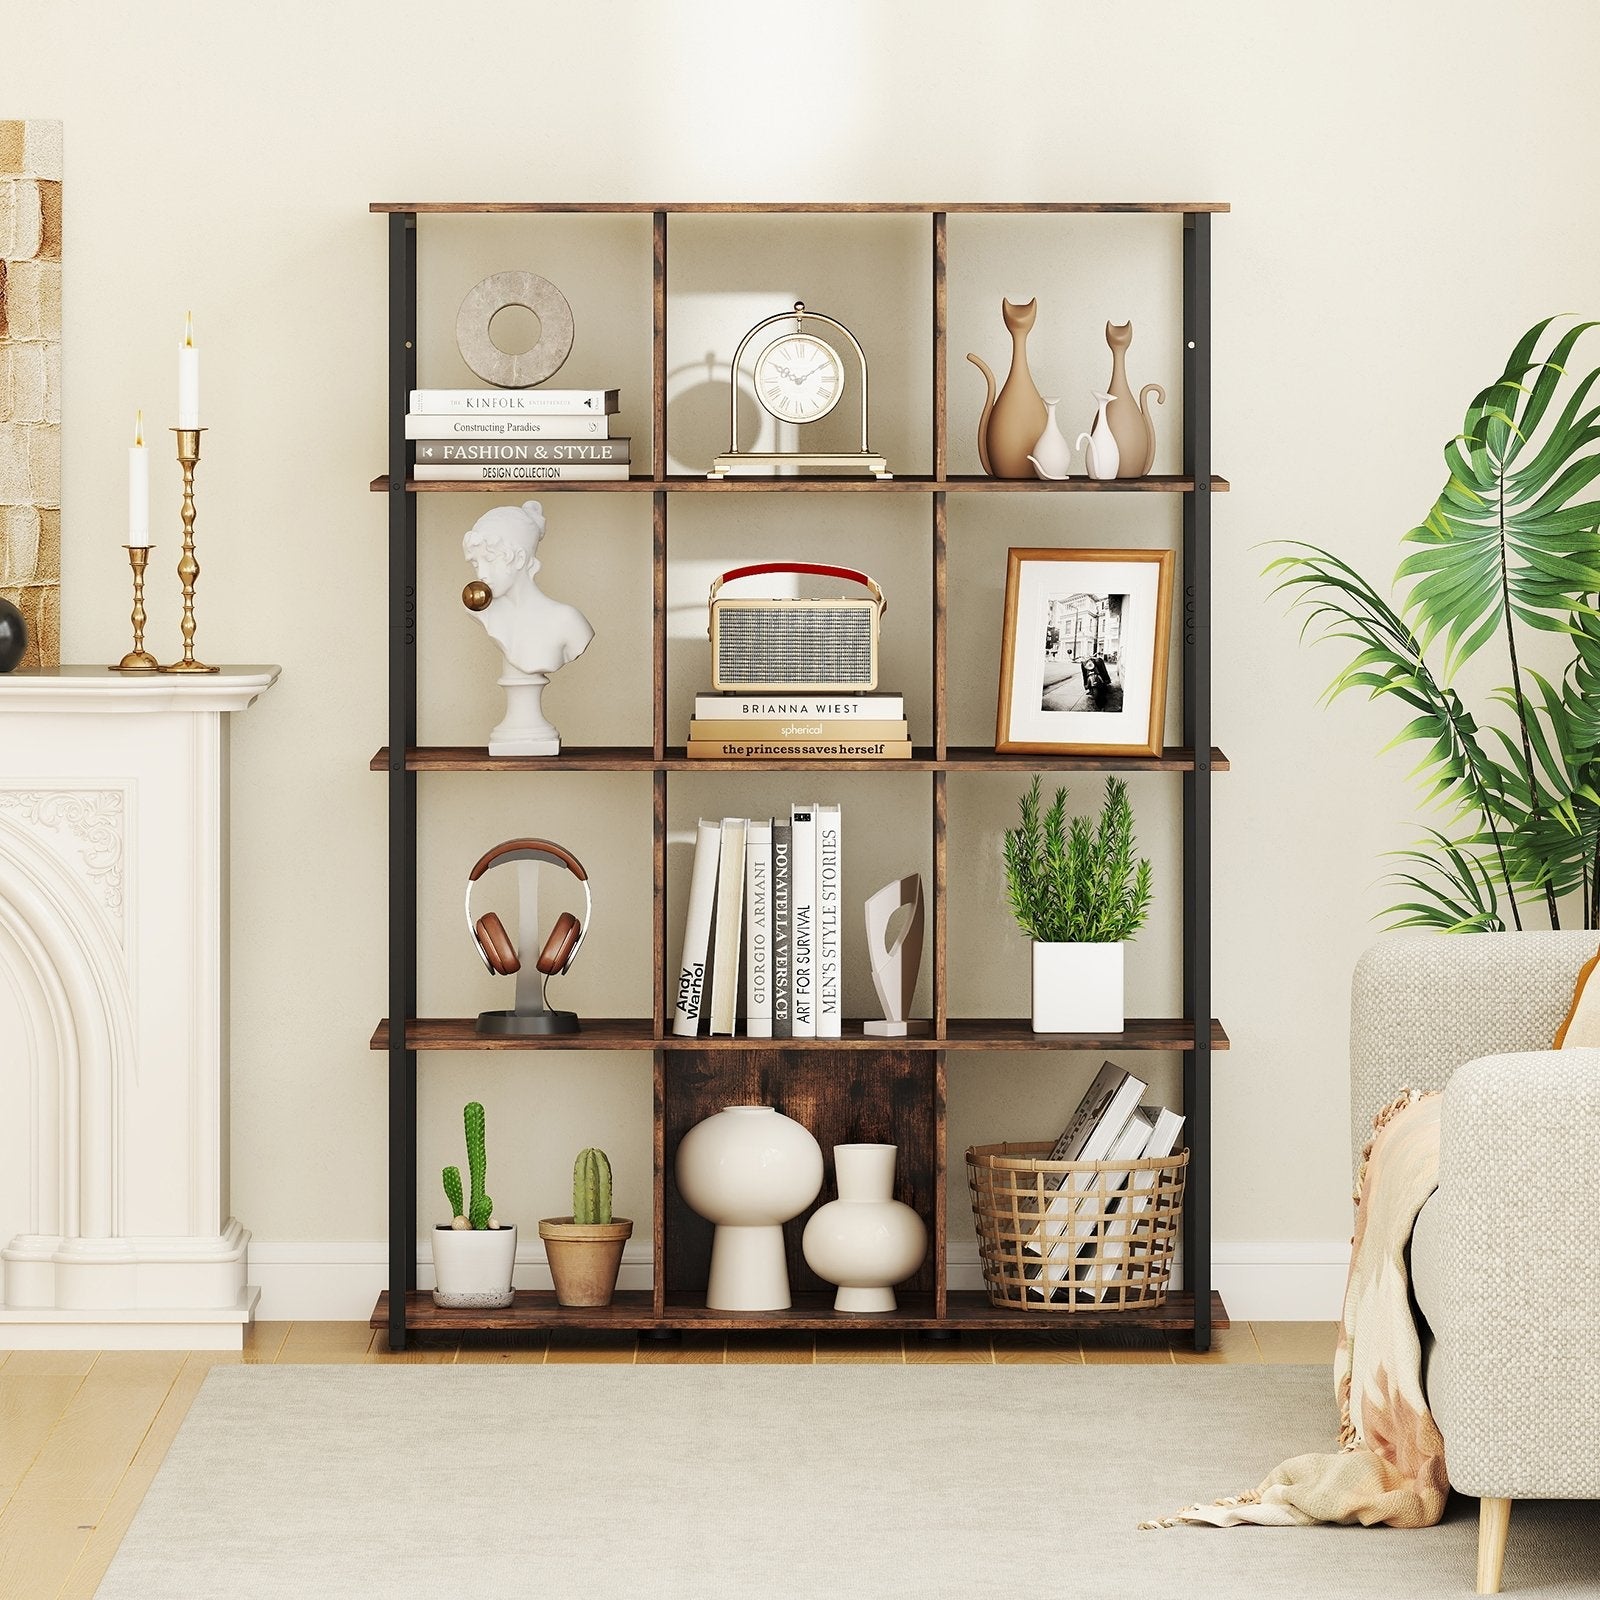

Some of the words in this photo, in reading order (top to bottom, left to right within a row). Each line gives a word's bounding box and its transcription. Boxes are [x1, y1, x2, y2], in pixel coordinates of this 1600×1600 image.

[466, 398, 525, 409] KINFOLK
[453, 422, 505, 435] Constructing
[507, 422, 541, 433] Paradies
[443, 445, 529, 460] FASHION
[534, 445, 549, 460] &
[553, 445, 613, 460] STYLE
[482, 467, 512, 479] DESIGN
[513, 467, 561, 479] COLLECTION
[742, 704, 809, 713] BRIANNA
[816, 704, 859, 713] WIEST
[781, 723, 823, 737] spherical
[722, 744, 745, 755] the
[746, 744, 801, 757] princess
[802, 747, 838, 755] saves
[839, 744, 886, 755] herself
[821, 830, 837, 901] STORIES
[753, 861, 766, 928] ARMANI
[775, 843, 788, 942] DONATELLA
[796, 904, 811, 964] SURVIVAL
[821, 905, 837, 958] STYLE
[753, 933, 766, 1004] GIORGIO
[775, 944, 788, 1021] VERSACE
[796, 968, 811, 995] FOR
[676, 967, 694, 1012] Andy
[686, 963, 704, 1020] Warhol
[796, 1000, 811, 1024] ART
